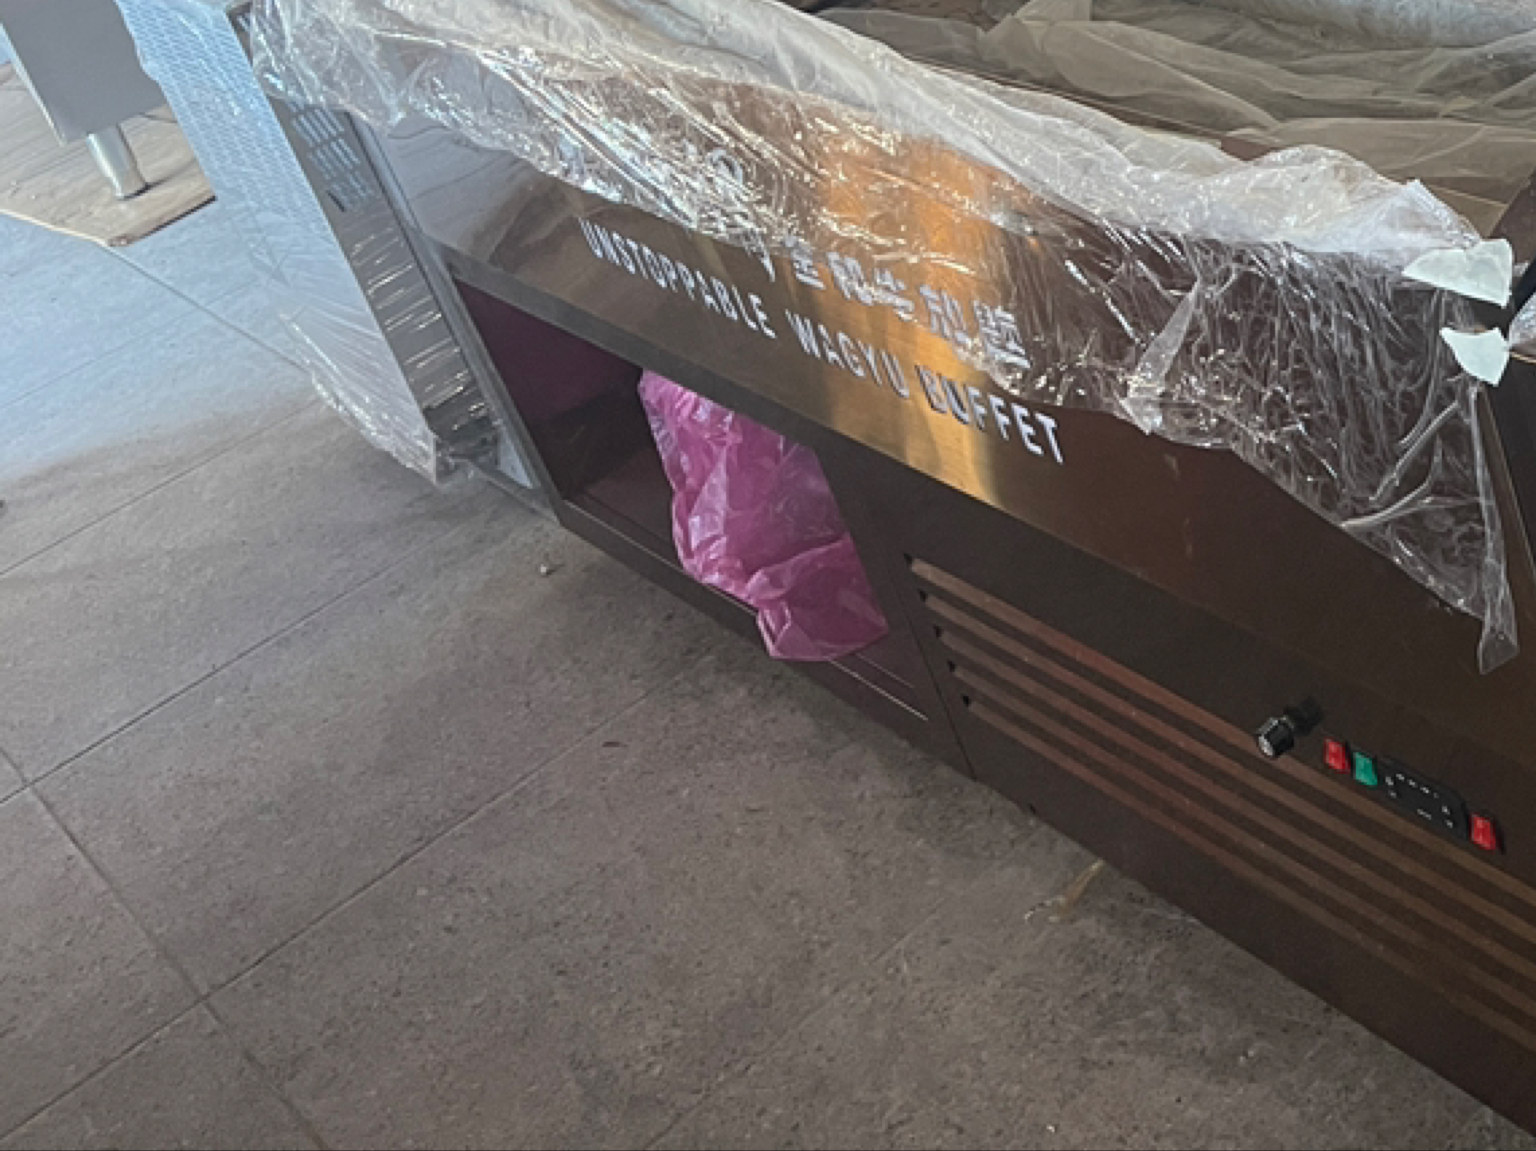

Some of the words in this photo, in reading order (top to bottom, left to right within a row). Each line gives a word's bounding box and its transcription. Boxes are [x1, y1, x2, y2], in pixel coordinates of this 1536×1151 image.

[578, 215, 777, 339] UNSTOPPABLE
[785, 308, 910, 399] WAGYU
[914, 364, 1065, 465] BUFFET
